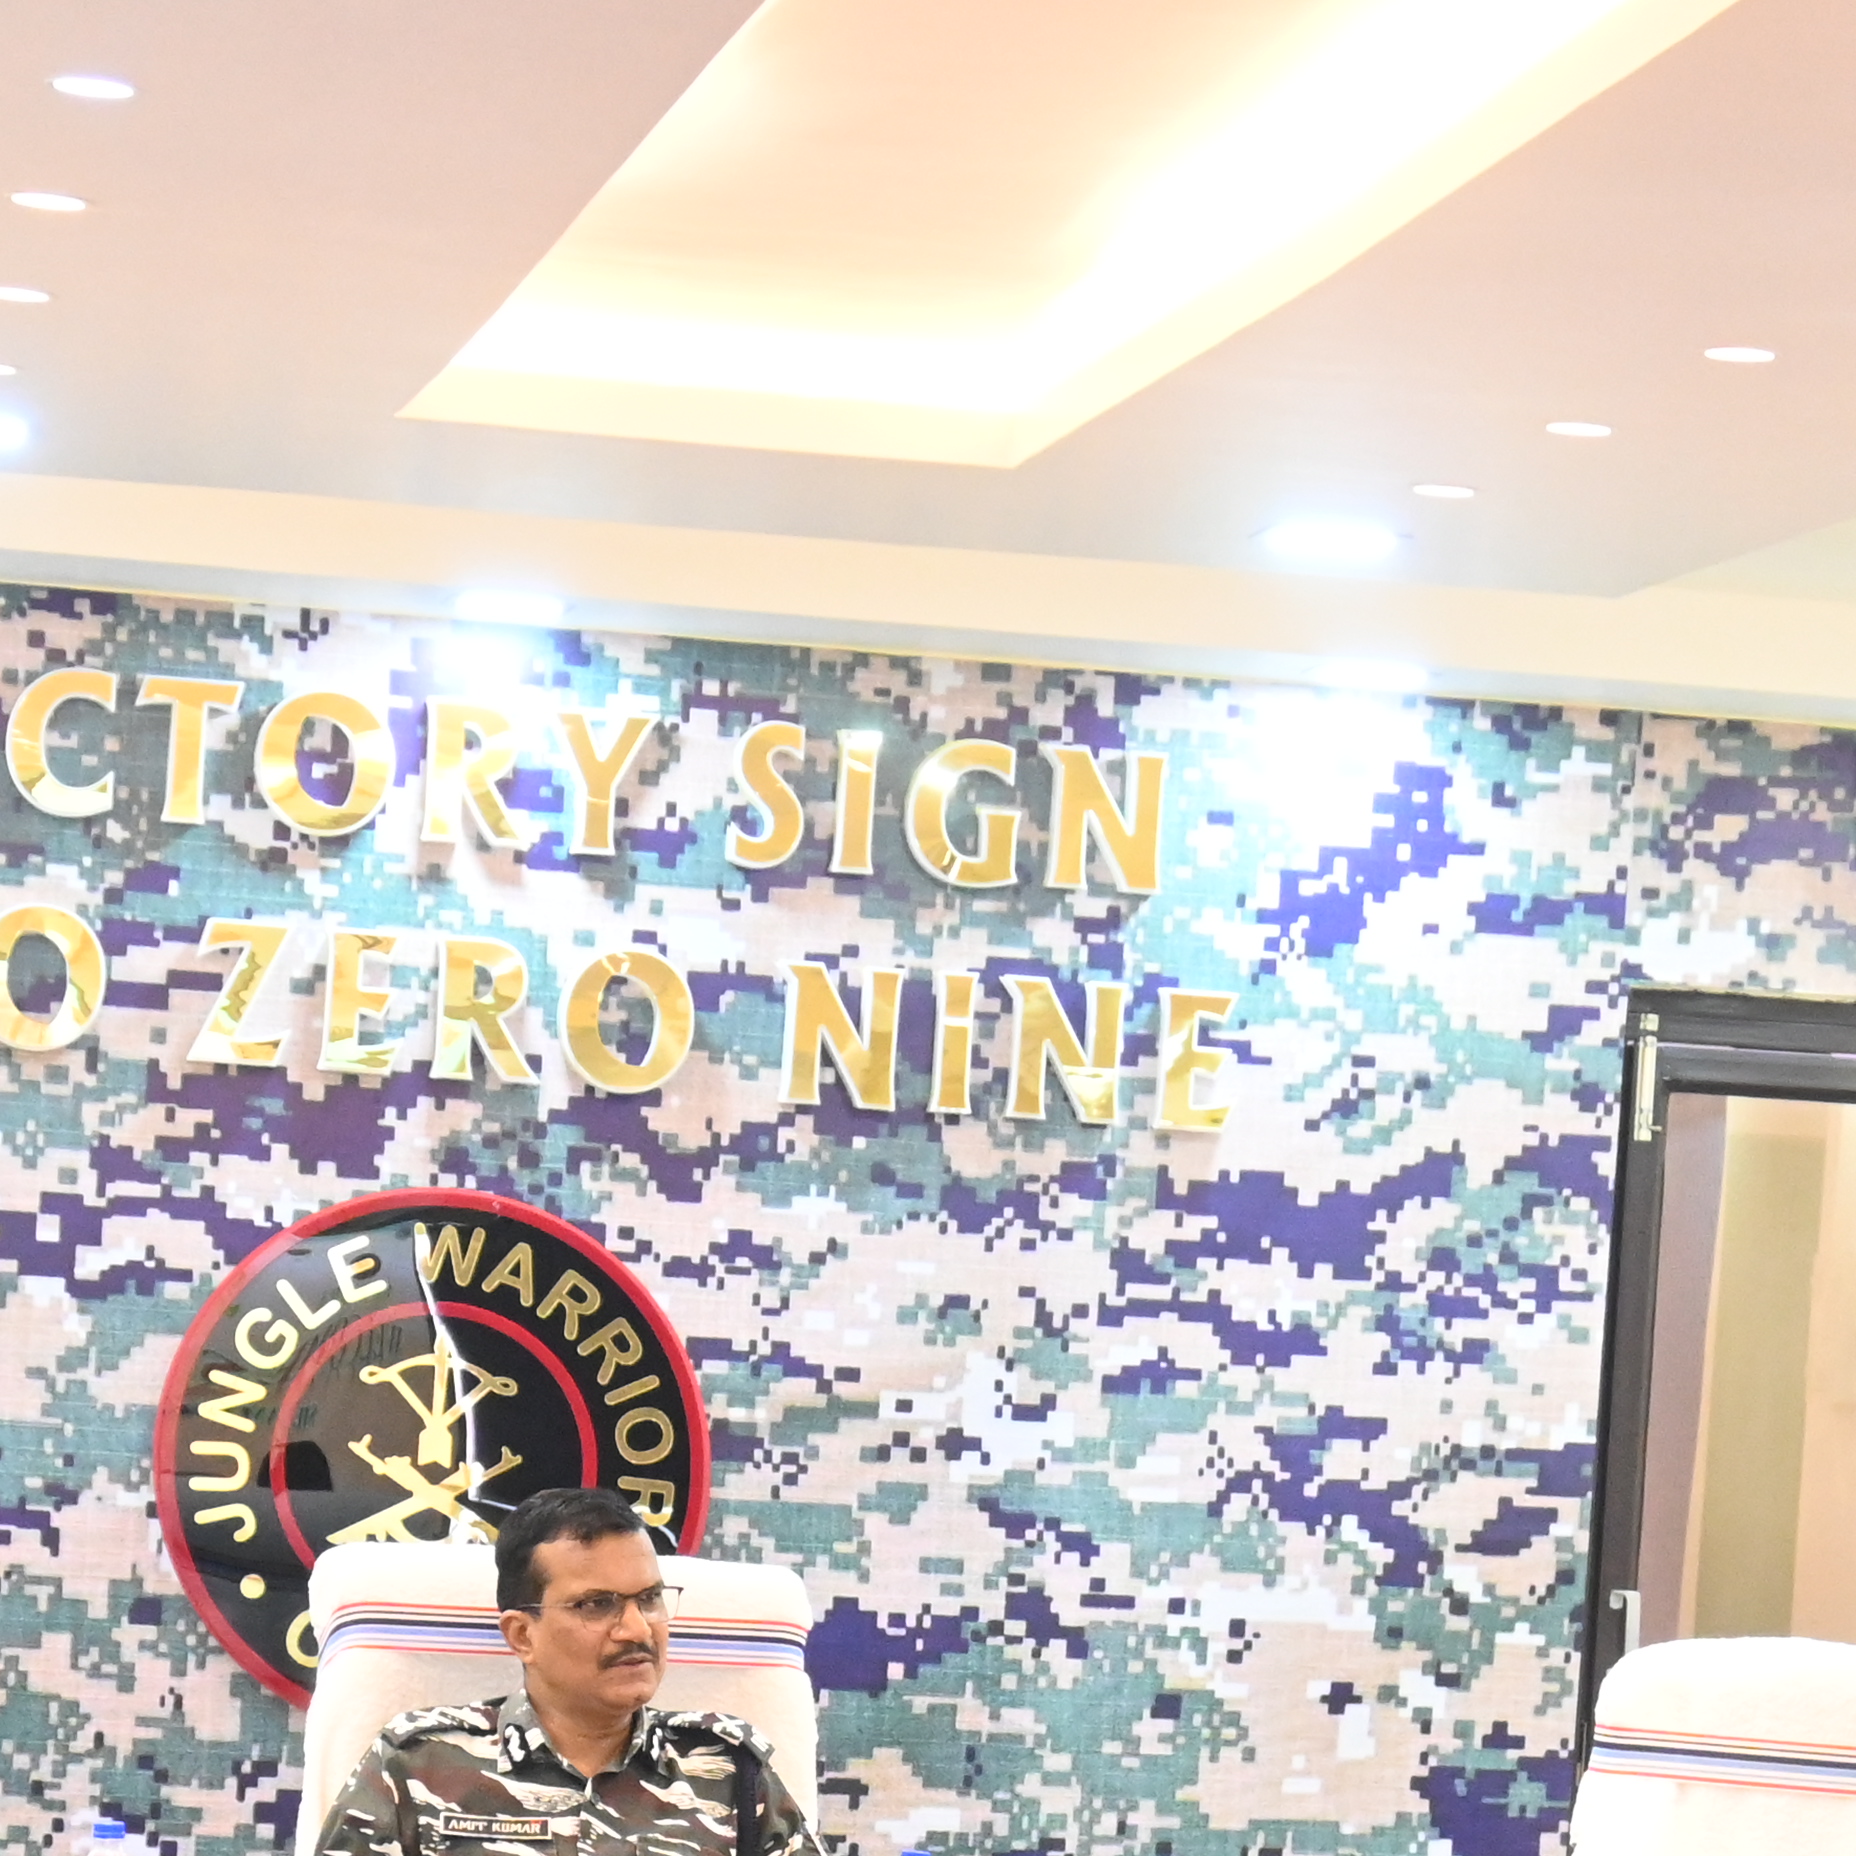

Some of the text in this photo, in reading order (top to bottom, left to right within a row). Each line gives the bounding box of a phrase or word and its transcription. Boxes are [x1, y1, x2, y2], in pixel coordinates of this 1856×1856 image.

[724, 719, 1166, 895] SIGN
[184, 915, 695, 1095] ZERO
[187, 1234, 388, 1544] JUNGLE
[448, 1819, 541, 1834] AMIT KUMAR
